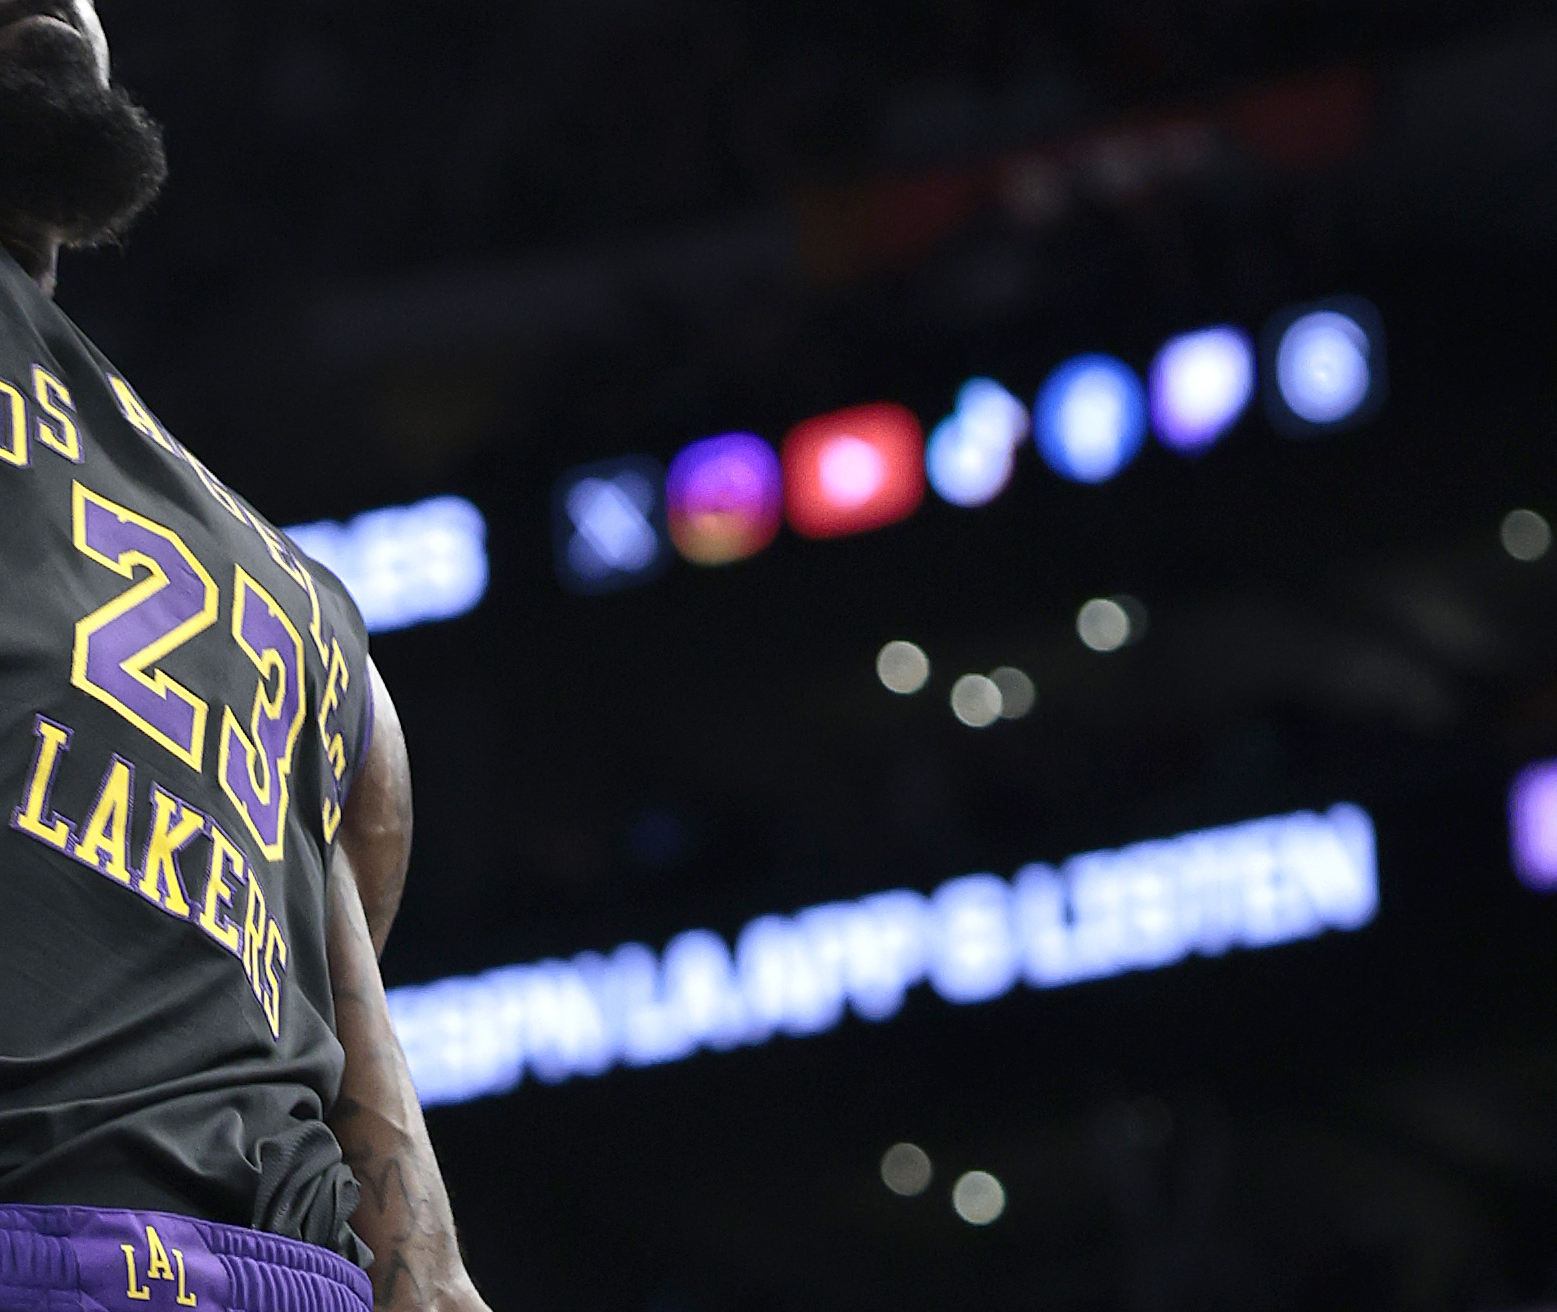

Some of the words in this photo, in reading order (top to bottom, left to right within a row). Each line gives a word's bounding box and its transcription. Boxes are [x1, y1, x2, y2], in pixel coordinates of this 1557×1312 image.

[71, 478, 307, 863] 23
[11, 712, 289, 1042] LAKERS
[120, 1224, 198, 1307] LAL
